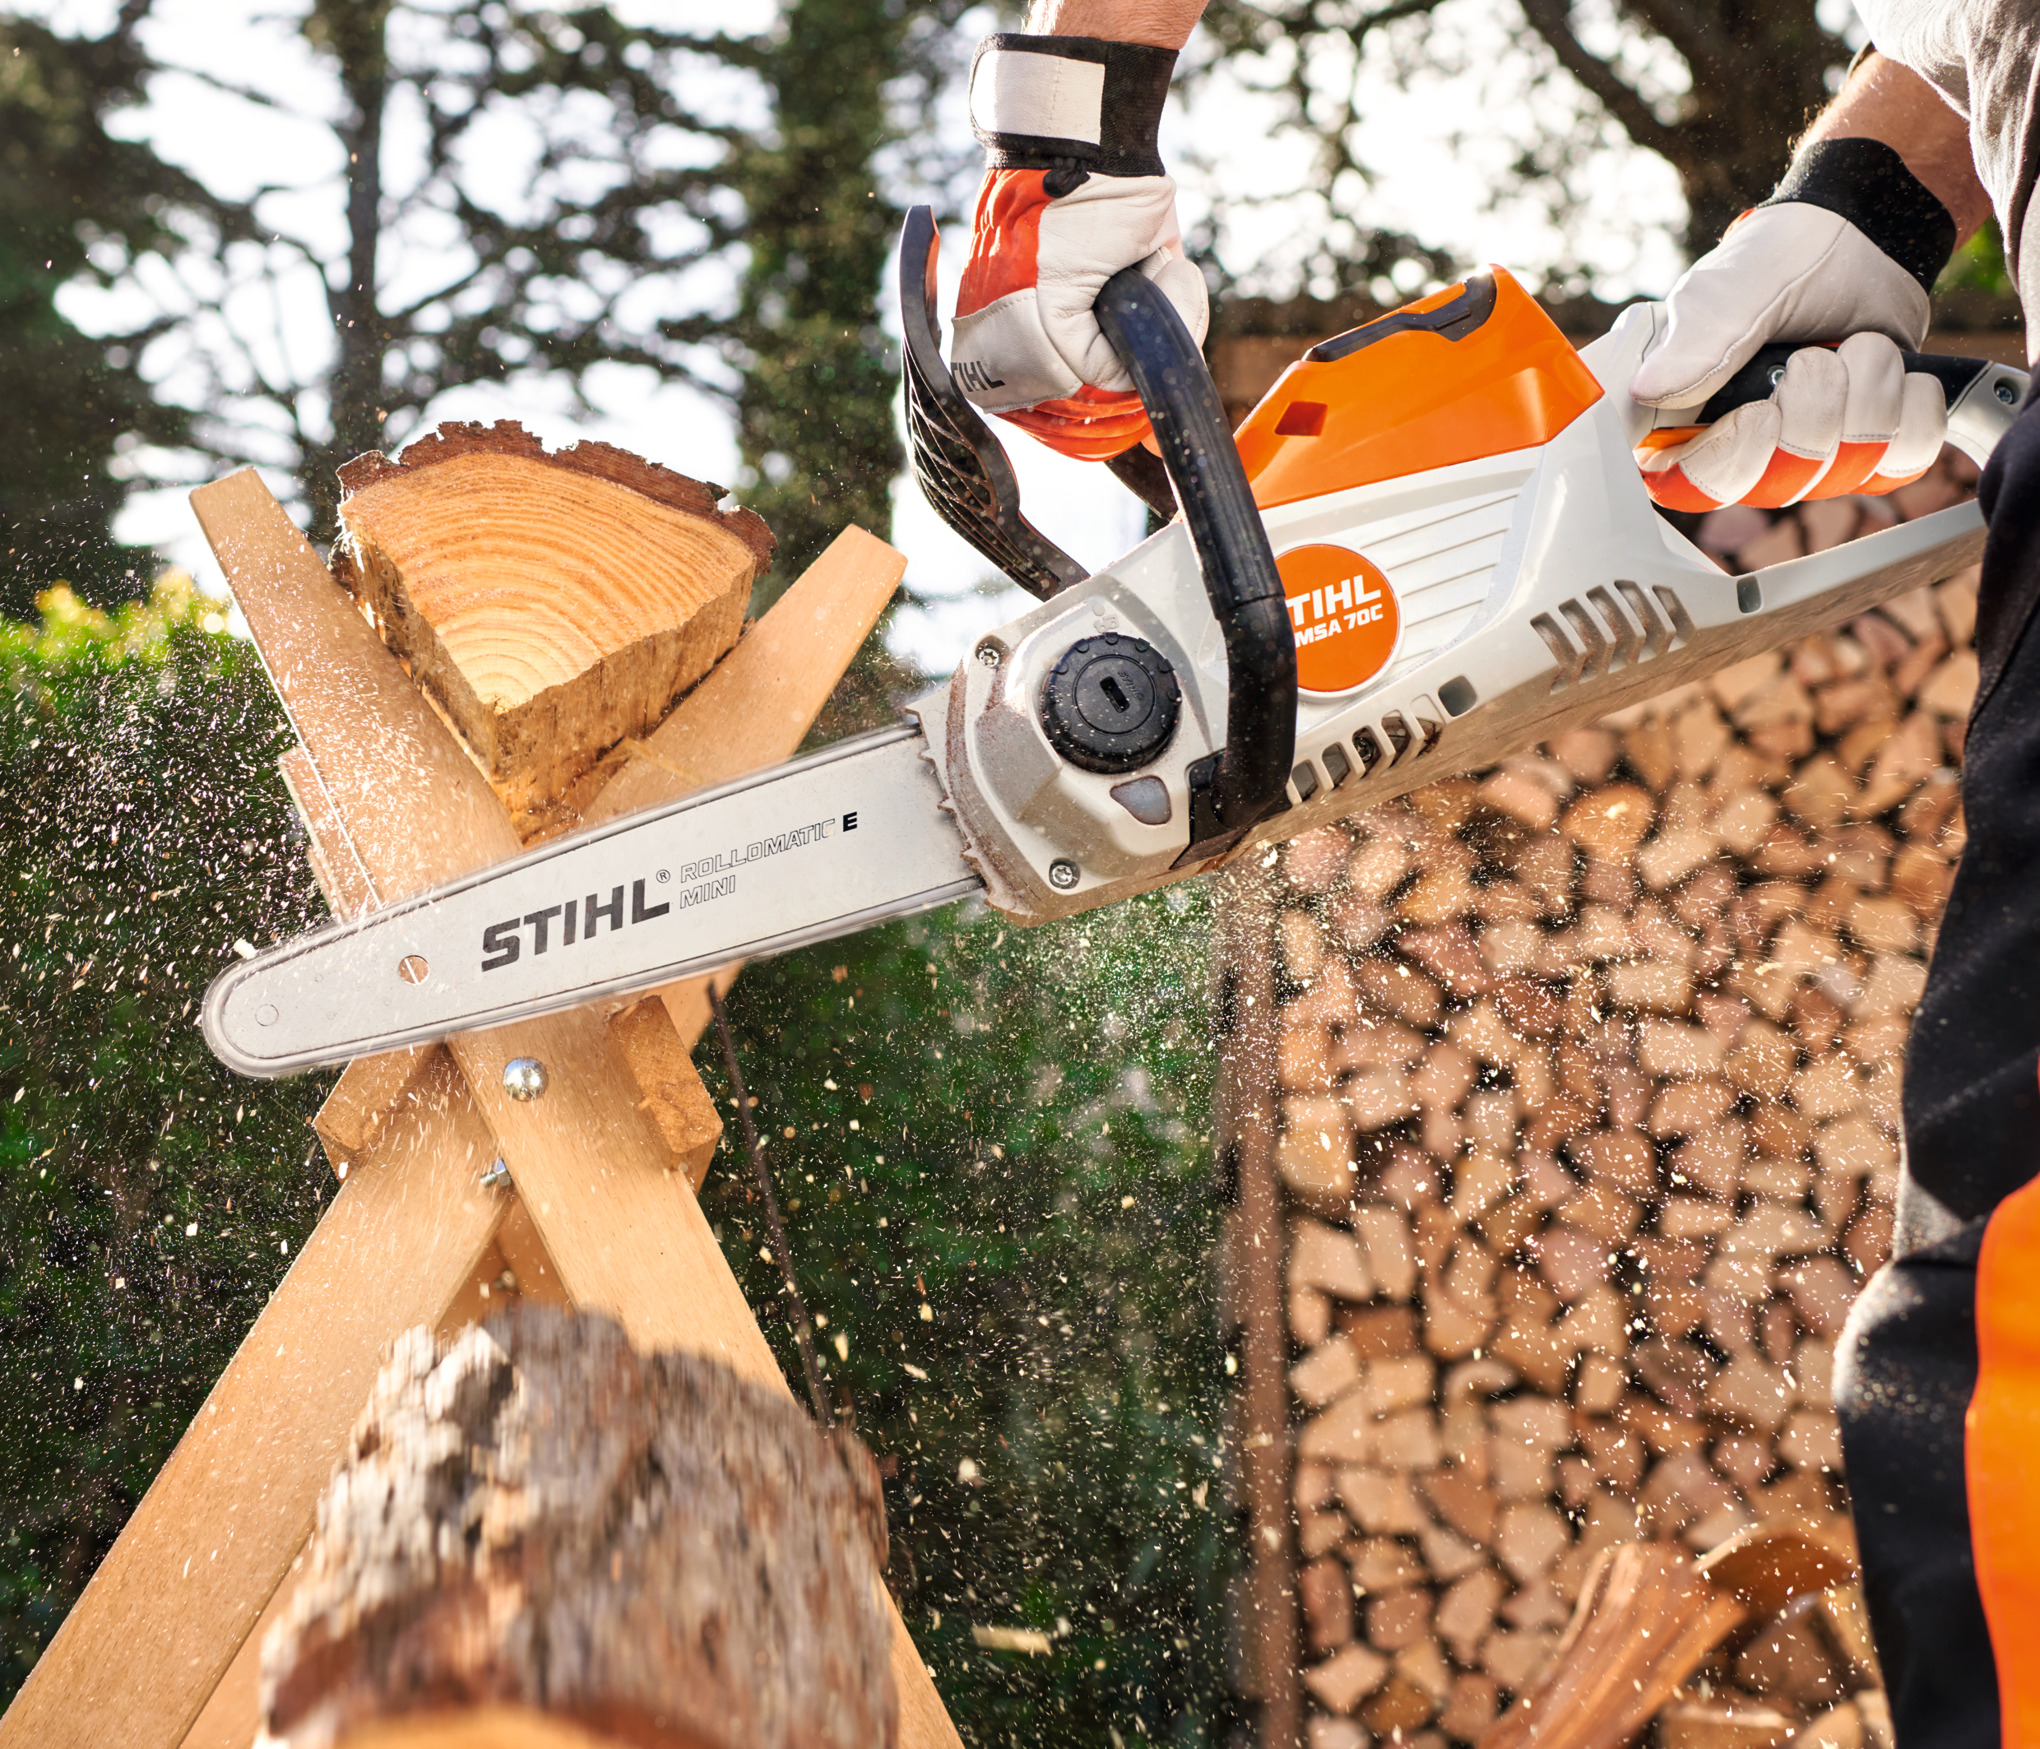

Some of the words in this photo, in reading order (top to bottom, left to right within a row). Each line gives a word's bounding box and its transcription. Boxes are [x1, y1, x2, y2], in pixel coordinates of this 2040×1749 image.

[950, 361, 1006, 392] TIHL
[1285, 574, 1382, 626] TIHL
[1294, 618, 1343, 648] MSA
[1343, 603, 1384, 630] 70C
[680, 818, 836, 884] ROLLOMATIC
[842, 811, 859, 833] E
[679, 874, 737, 910] MINI
